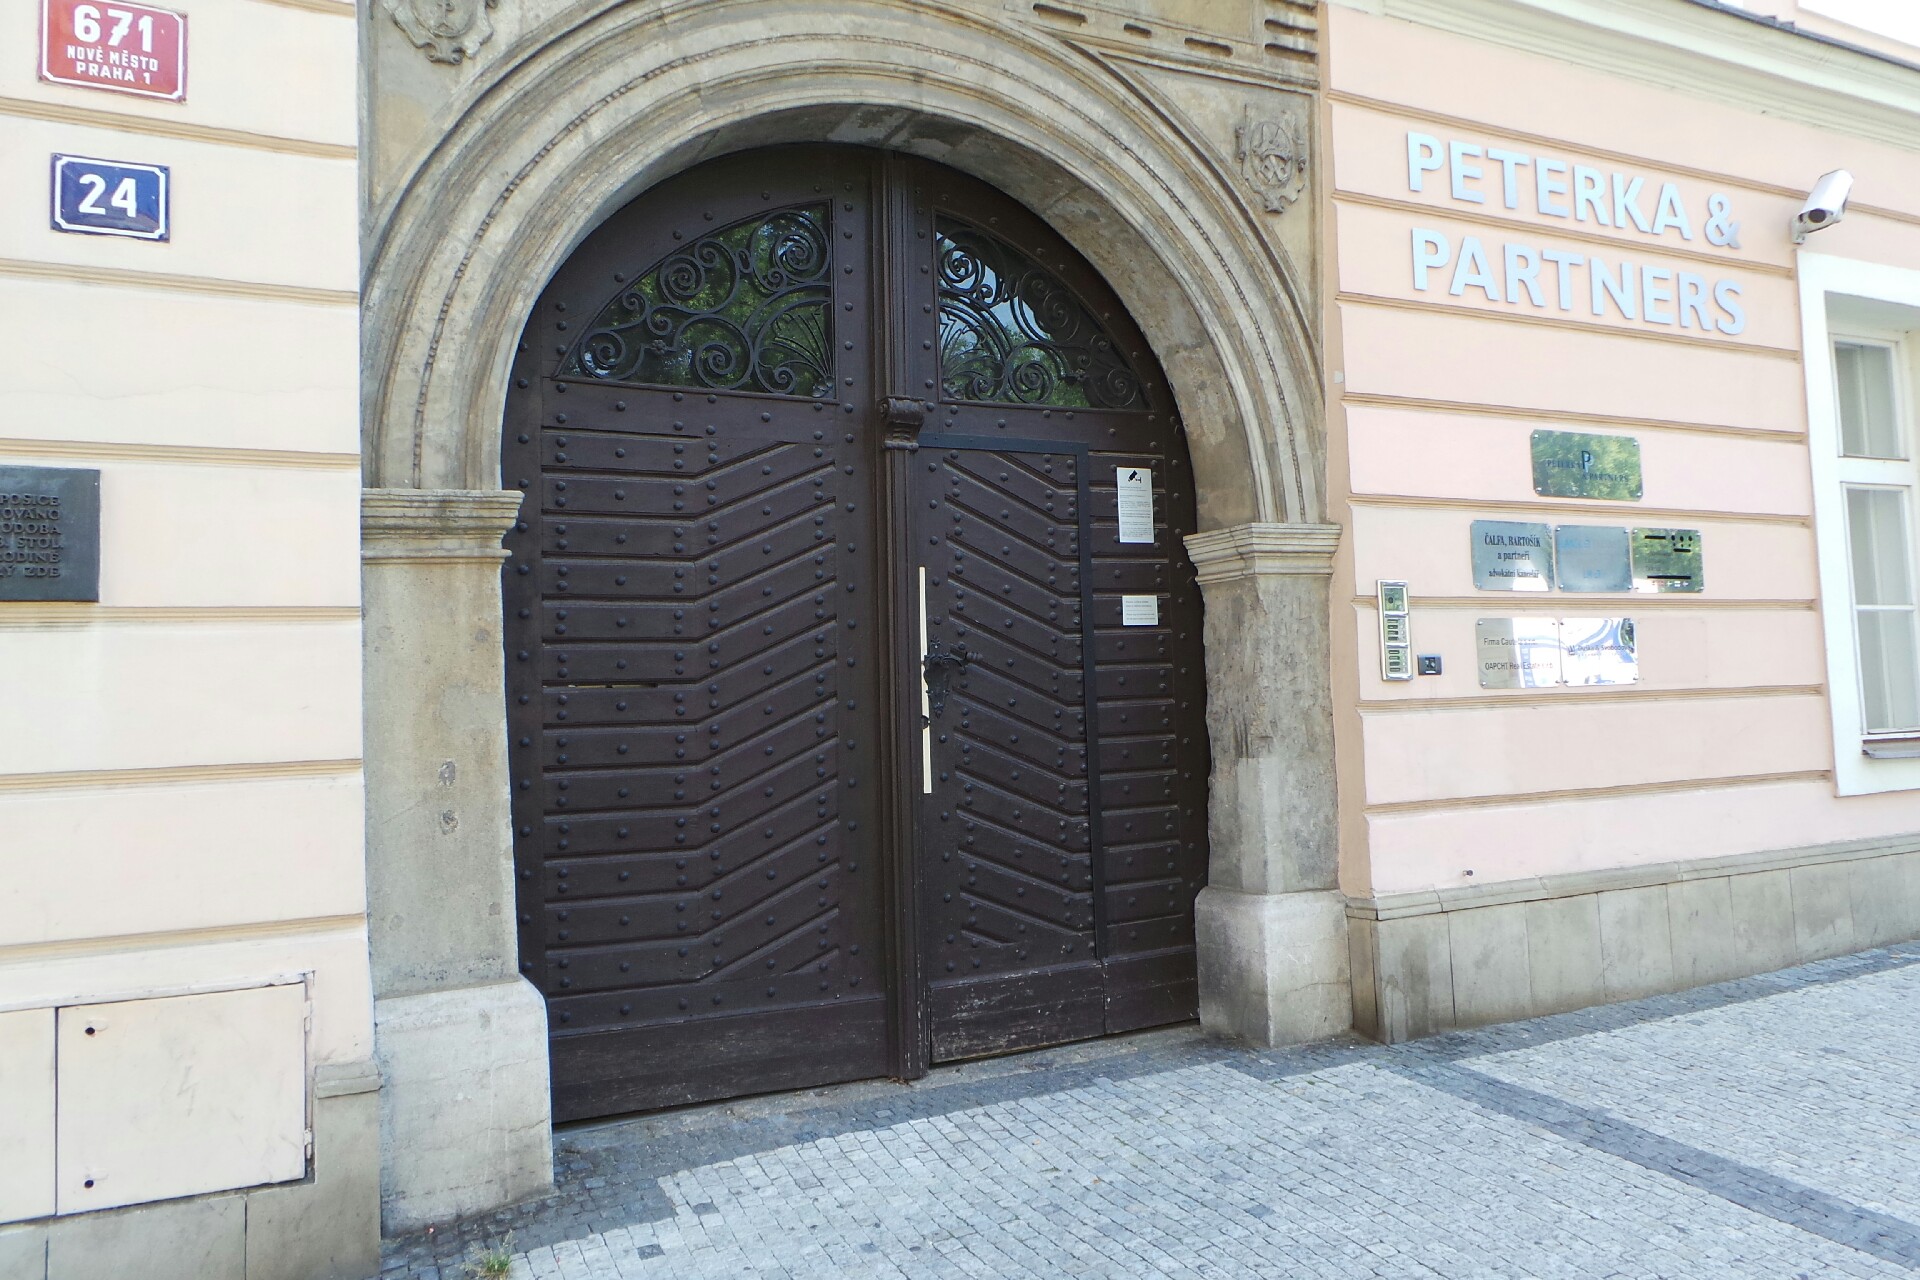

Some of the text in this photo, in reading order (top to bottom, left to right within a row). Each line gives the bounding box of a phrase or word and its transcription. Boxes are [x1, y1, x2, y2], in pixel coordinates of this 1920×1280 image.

[74, 4, 154, 53] 671
[67, 45, 159, 72] NOVÉ MĚSTO
[76, 61, 151, 85] PRAHA 1
[78, 173, 137, 218] 24
[1406, 130, 1741, 250] PETERKA &
[1411, 227, 1746, 336] PARTNERS
[1497, 552, 1502, 560] a
[1483, 637, 1500, 646] Firma
